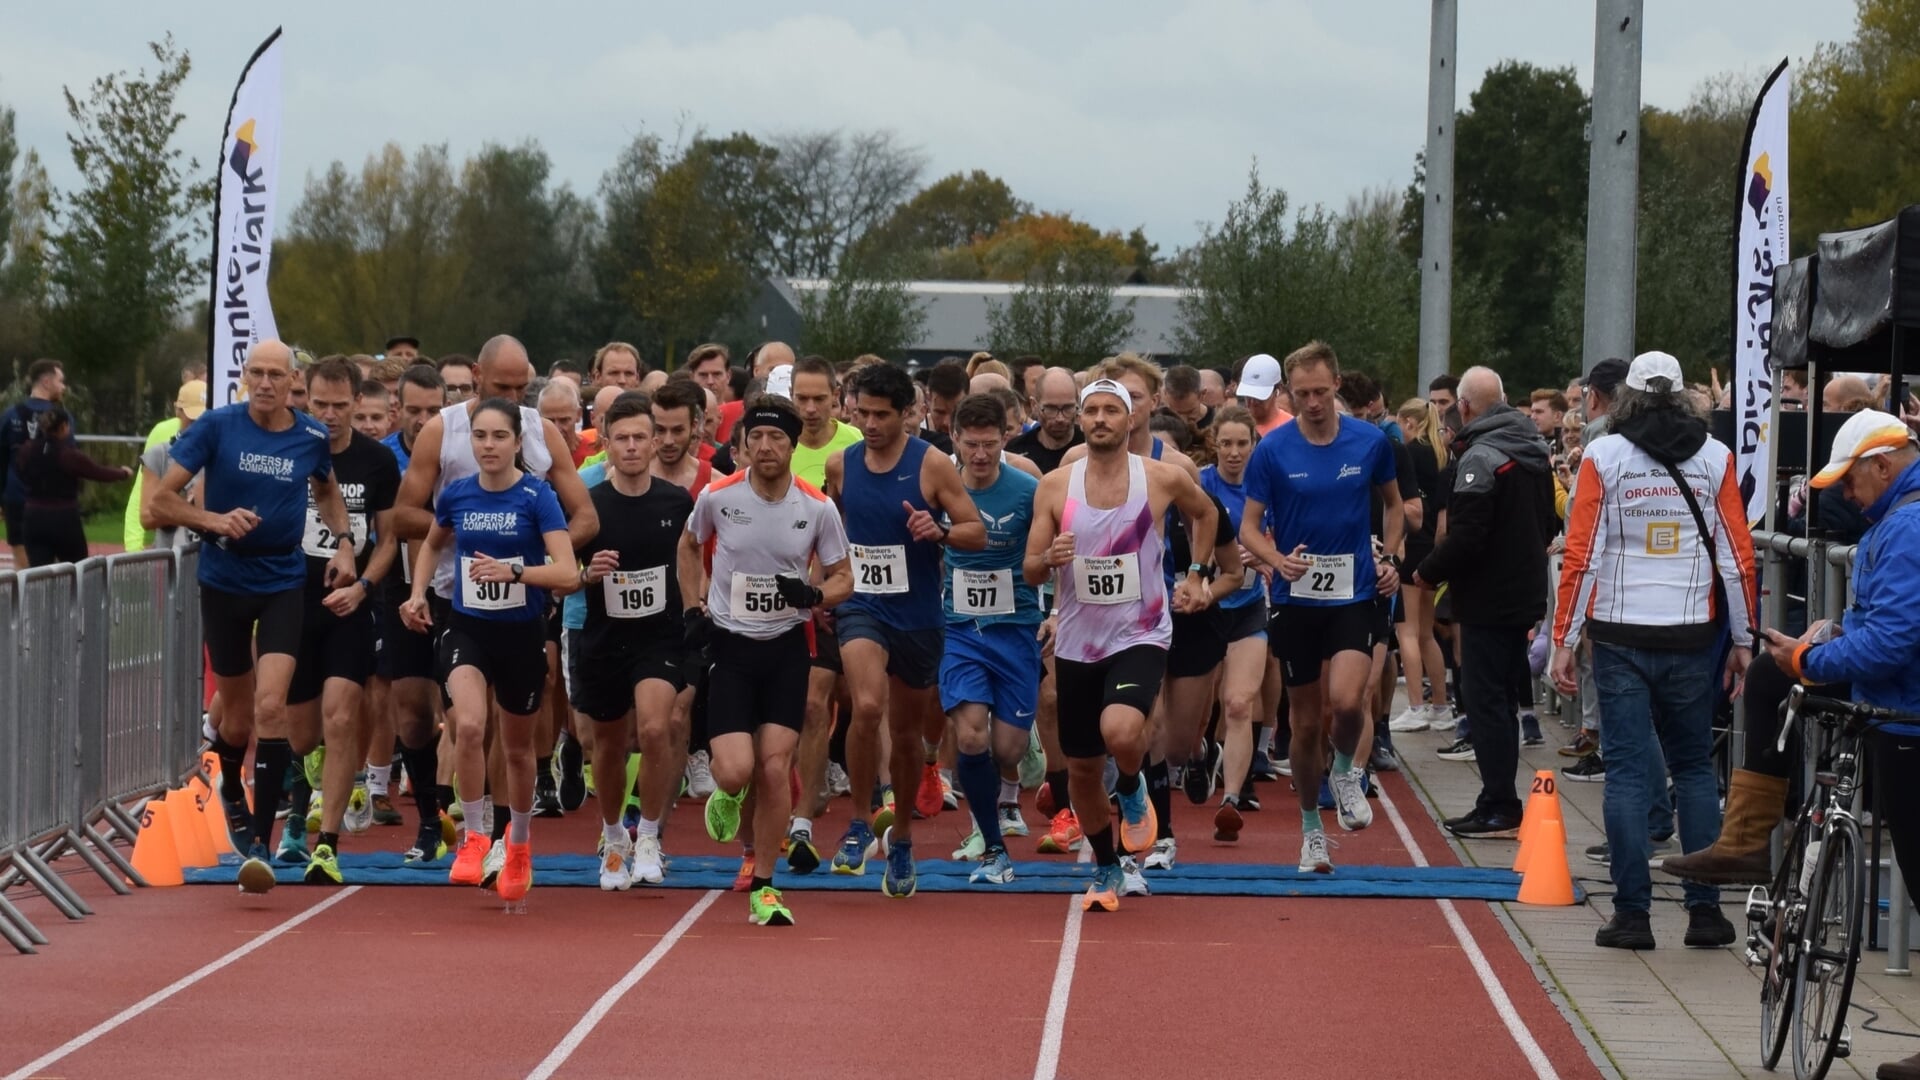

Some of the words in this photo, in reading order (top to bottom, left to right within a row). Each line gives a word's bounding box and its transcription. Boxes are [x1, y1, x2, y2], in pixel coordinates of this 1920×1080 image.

[239, 461, 281, 476] COMPANY
[240, 451, 282, 467] LOPERS
[1625, 486, 1703, 500] ORGANISIE
[464, 512, 504, 523] LOPERS
[1624, 509, 1668, 517] GEBHARD
[463, 521, 505, 531] COMPANY
[861, 563, 893, 585] 281
[1311, 571, 1335, 592] 22
[476, 580, 512, 601] 307
[1088, 574, 1124, 596] 587
[618, 586, 654, 610] 196
[745, 591, 786, 613] 556
[967, 587, 997, 607] 577
[203, 758, 214, 775] 5
[1532, 777, 1555, 795] 20
[141, 809, 155, 829] 5
